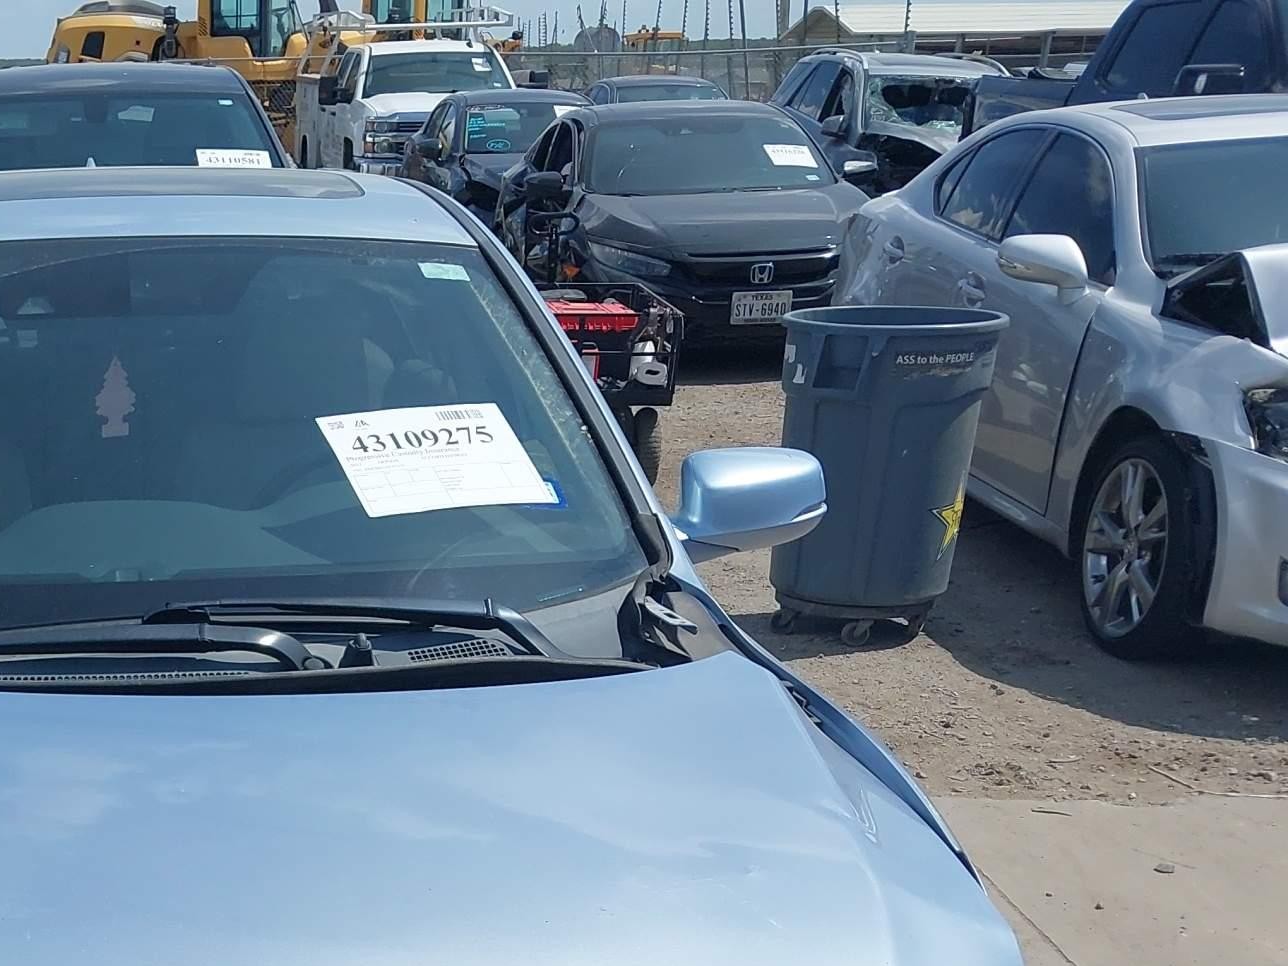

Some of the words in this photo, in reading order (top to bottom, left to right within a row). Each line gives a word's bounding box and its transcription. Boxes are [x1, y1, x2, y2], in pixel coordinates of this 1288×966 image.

[735, 302, 787, 318] STV-6940
[895, 354, 916, 365] ASS
[917, 355, 928, 364] to
[929, 354, 945, 364] the
[945, 352, 974, 364] PEOPLE
[352, 426, 494, 453] 43109275
